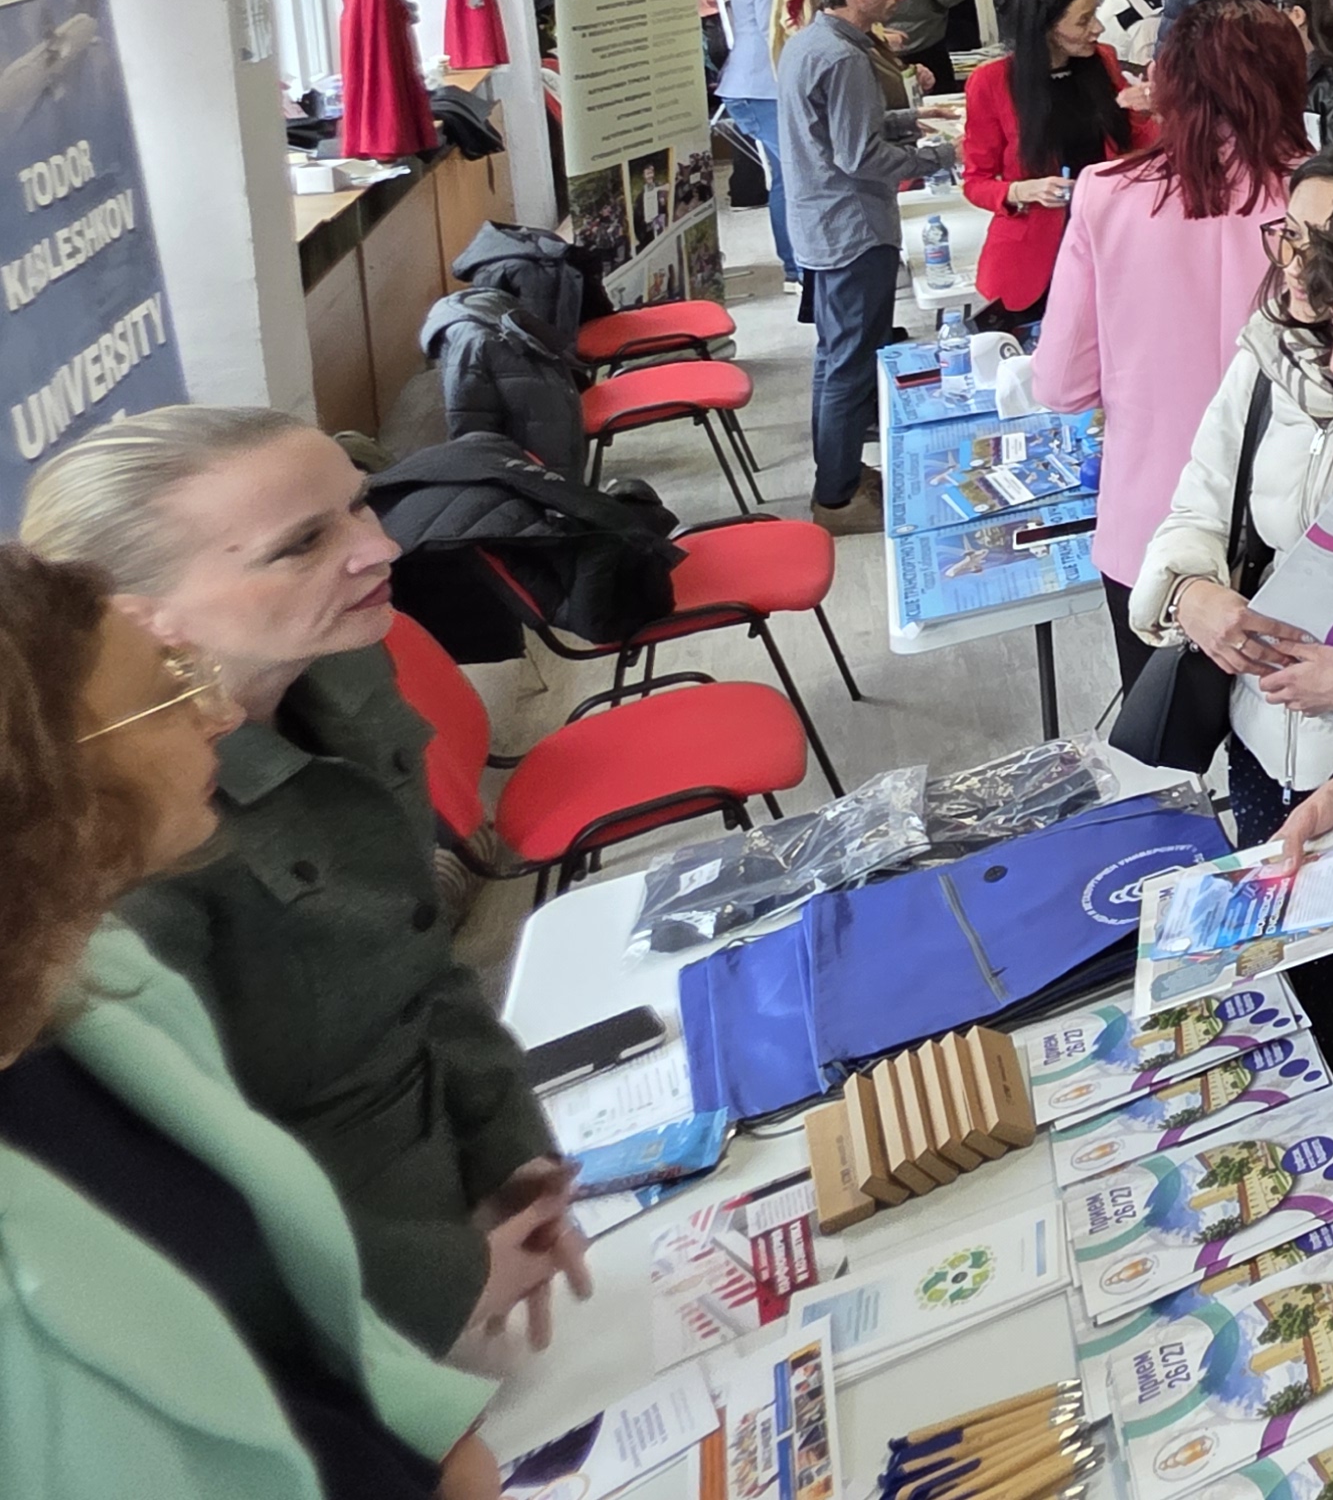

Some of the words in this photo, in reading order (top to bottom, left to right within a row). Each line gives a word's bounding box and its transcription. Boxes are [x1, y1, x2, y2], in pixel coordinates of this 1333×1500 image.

[18, 139, 96, 213] TODOR
[11, 292, 167, 460] UNIVERSITY
[1064, 1028, 1086, 1058] 26/27
[1110, 1186, 1137, 1224] 26/27
[1159, 1342, 1191, 1389] 26/27
